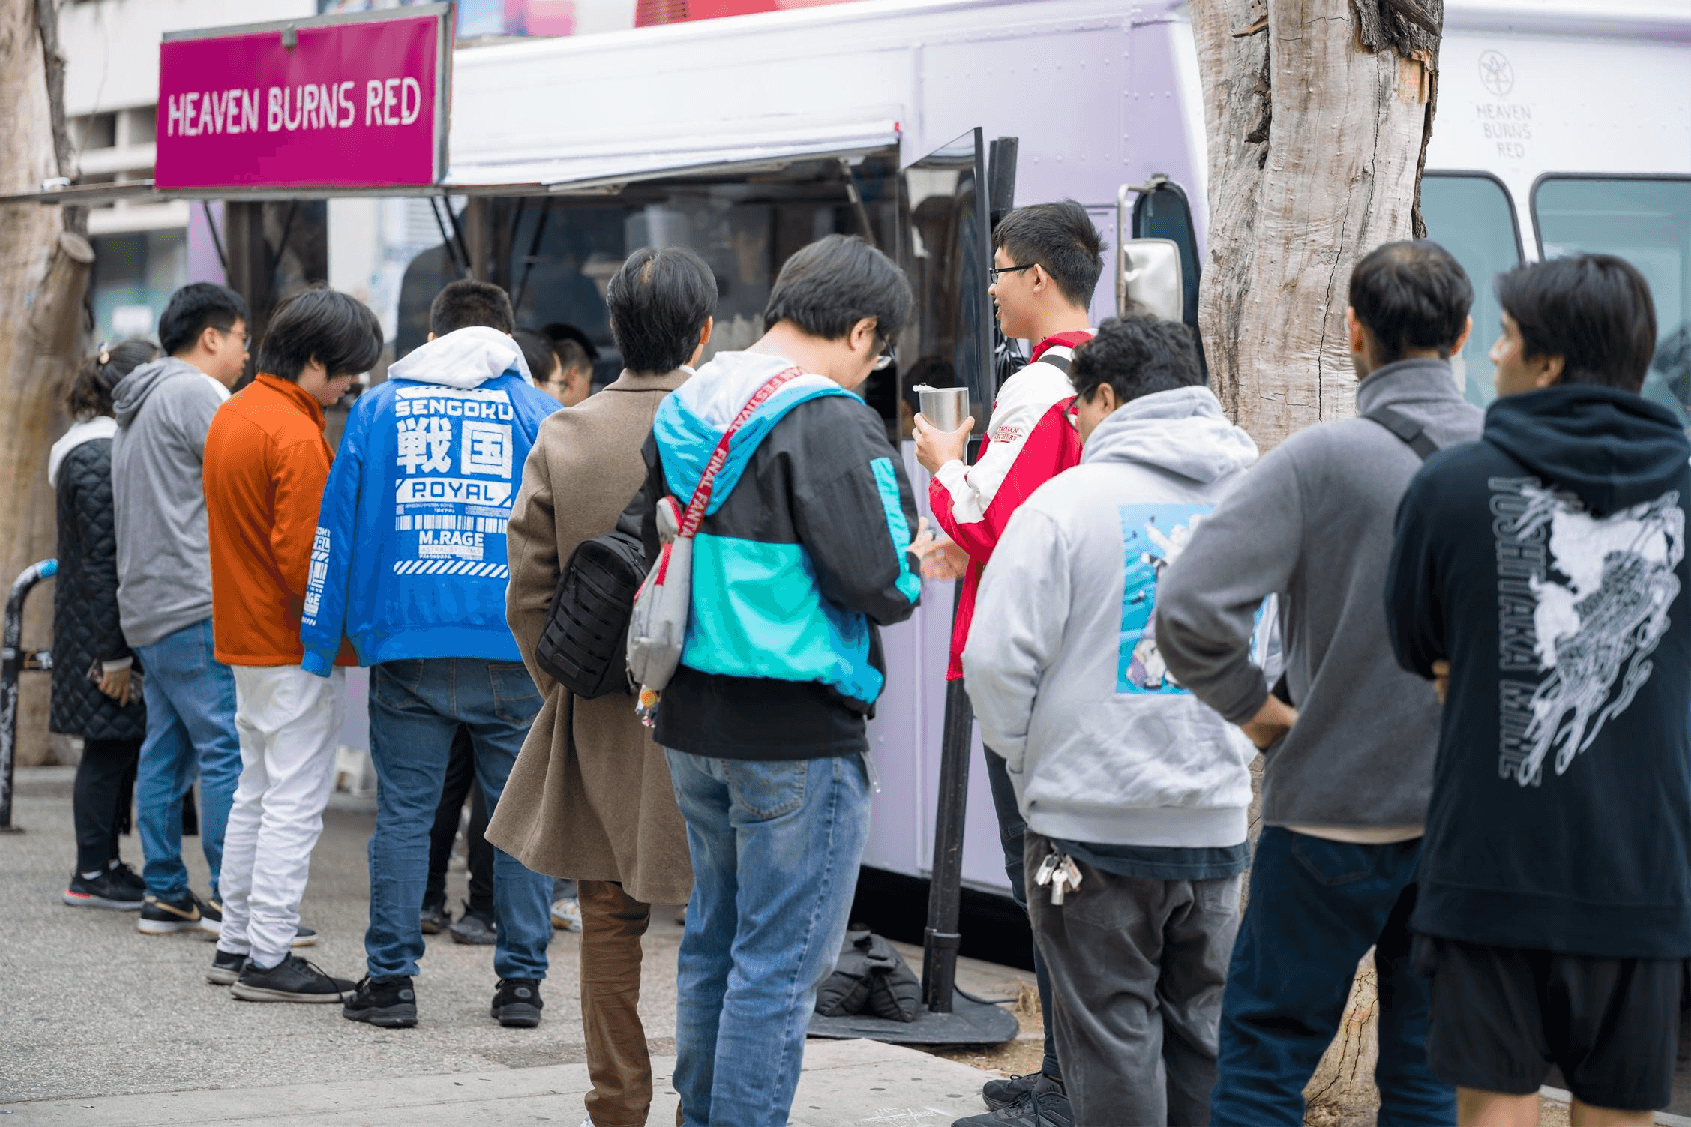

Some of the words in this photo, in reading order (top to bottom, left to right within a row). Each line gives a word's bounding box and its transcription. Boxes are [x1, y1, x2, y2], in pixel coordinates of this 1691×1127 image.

[167, 88, 260, 137] HEAVEN
[267, 80, 355, 132] BURNS
[365, 76, 422, 127] RED
[1475, 103, 1532, 120] HEAVEN
[1482, 121, 1532, 140] BURNS
[1496, 141, 1525, 158] RED
[395, 399, 514, 421] SENGOKU
[396, 416, 513, 480] 戦国
[698, 447, 728, 489] FINAL
[411, 481, 496, 502] ROYAL
[419, 530, 485, 548] M.RAGE
